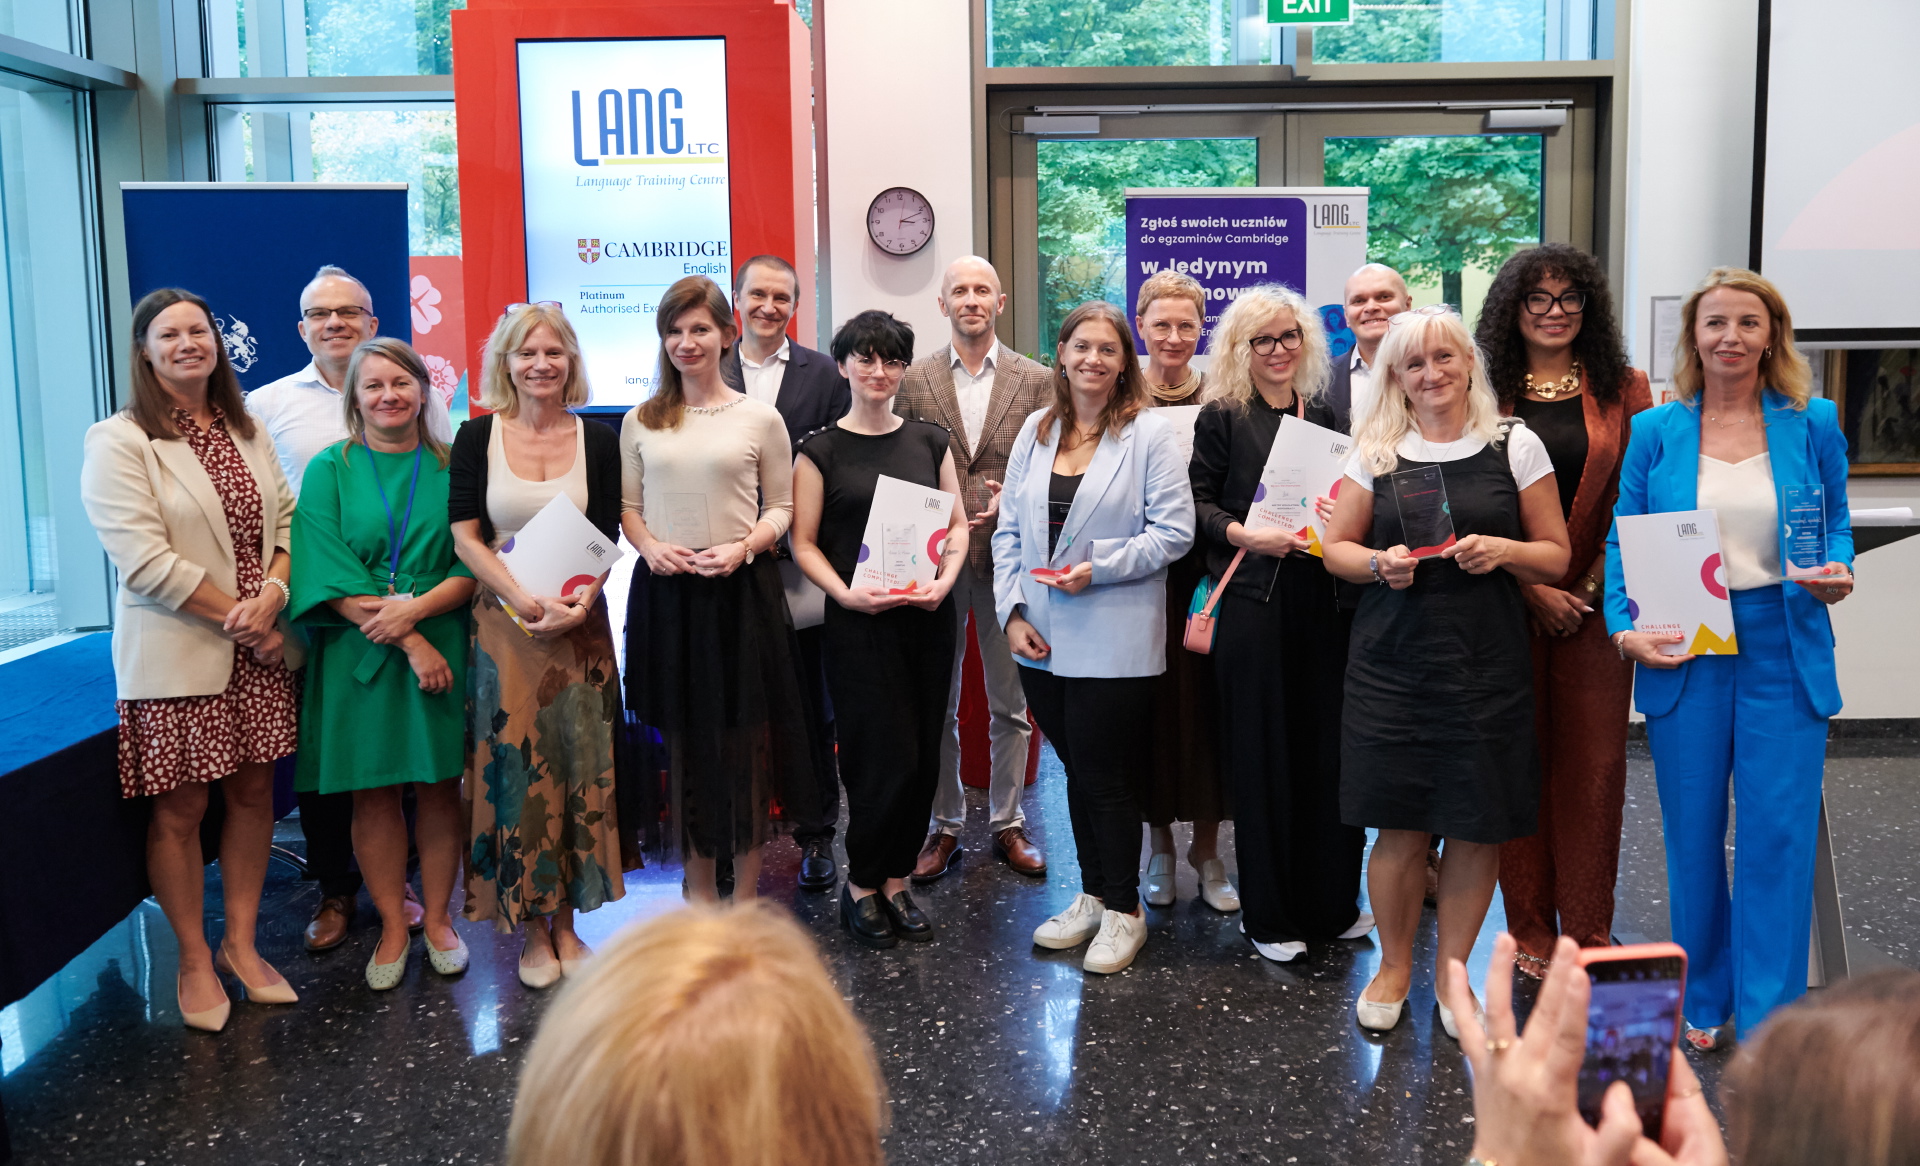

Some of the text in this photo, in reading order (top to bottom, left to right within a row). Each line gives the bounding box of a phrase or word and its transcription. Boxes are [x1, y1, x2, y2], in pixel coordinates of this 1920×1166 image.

[572, 88, 720, 166] LANG LTC
[576, 174, 726, 192] Language Training Centre
[1140, 216, 1288, 230] Zgłoś swoich uczniów
[1314, 204, 1349, 228] LANG
[1140, 233, 1288, 246] do egzaminów Cambridge
[604, 241, 728, 258] CAMBRIDGE
[684, 263, 726, 275] English
[1140, 258, 1268, 279] w Jedynym
[580, 291, 625, 300] Platinum
[580, 304, 640, 314] Authorised
[1677, 523, 1697, 537] LANG
[586, 540, 606, 558] LANG
